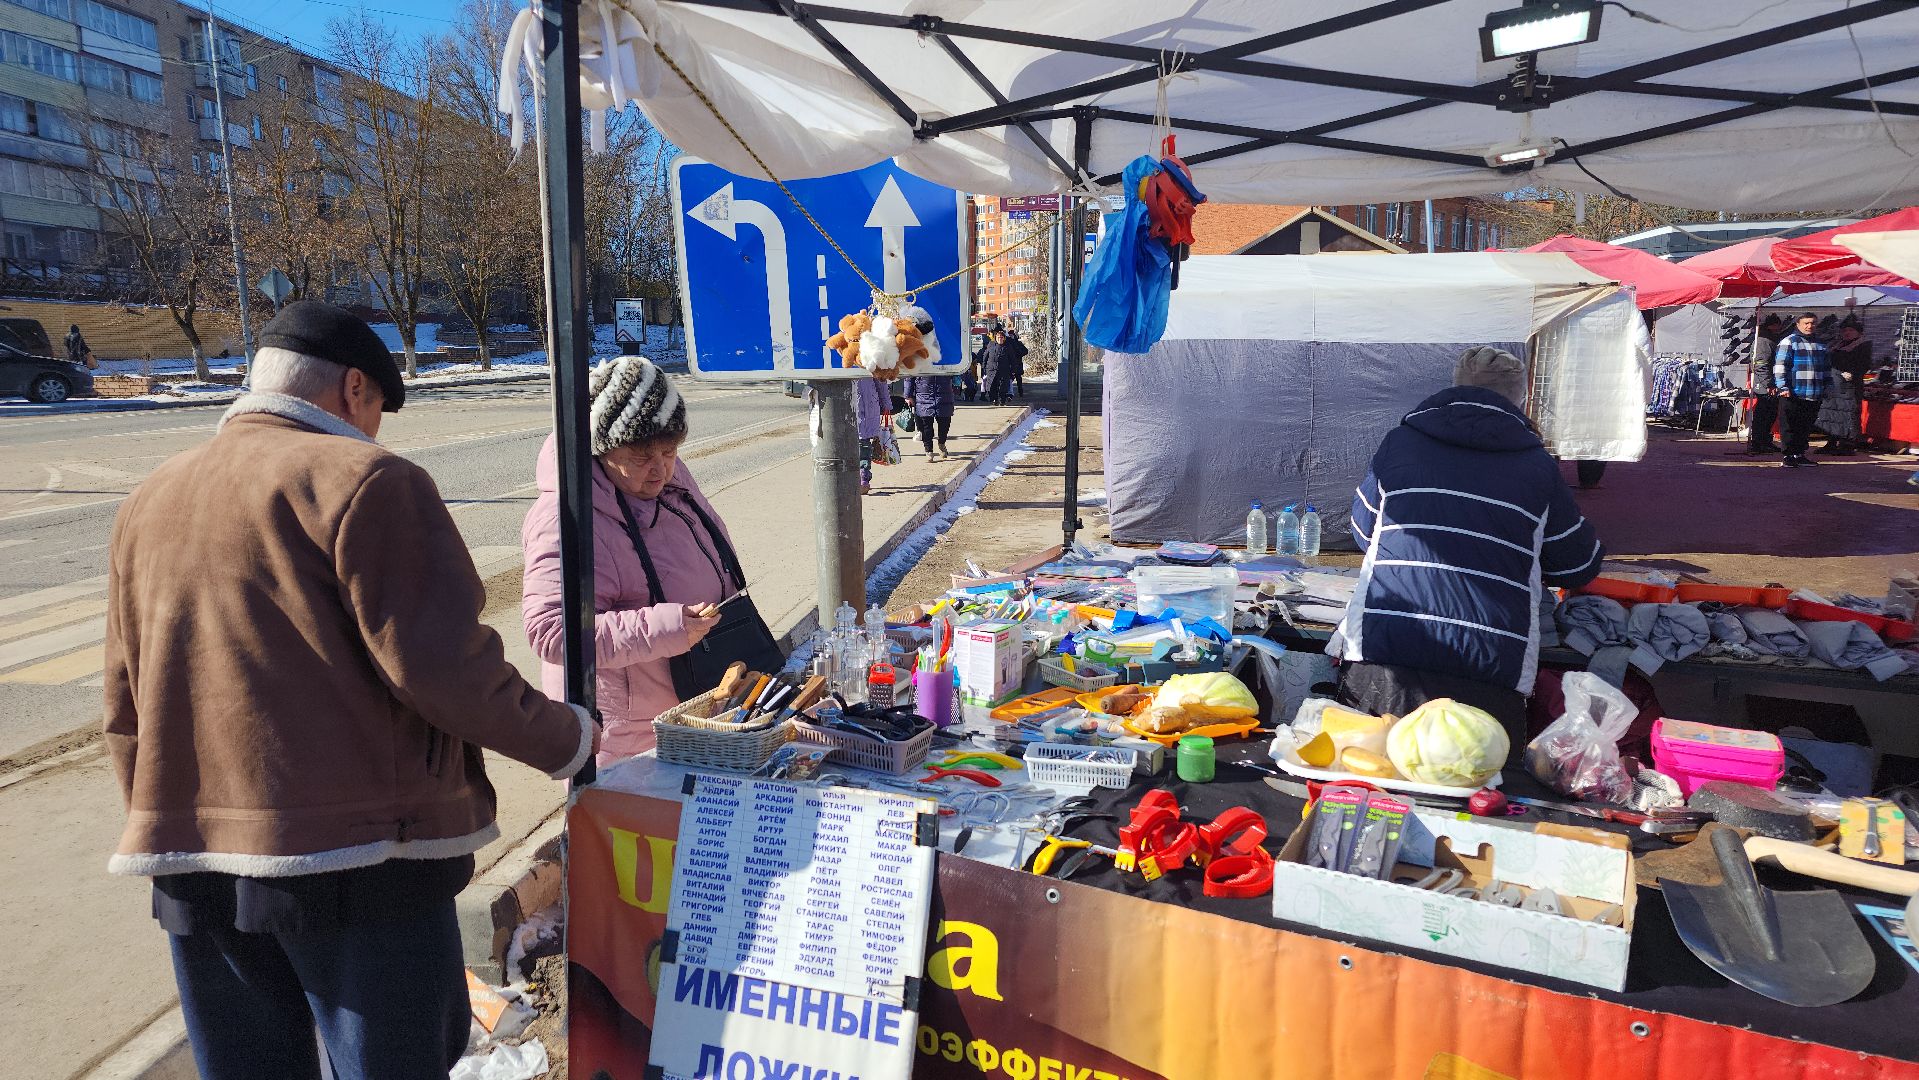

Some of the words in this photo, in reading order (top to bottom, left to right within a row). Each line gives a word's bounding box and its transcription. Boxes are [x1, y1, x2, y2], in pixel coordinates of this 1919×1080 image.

[697, 775, 742, 787] АЛЕКСАНДР
[703, 786, 734, 796] АНДРЕЙ
[754, 783, 797, 793] АНАТОЛИЙ
[756, 793, 793, 804] АРКАДИЙ
[823, 792, 845, 800] ИЛЬЯ
[695, 796, 739, 807] АФАНАСИЙ
[806, 800, 863, 812] КОНСТАНТИН
[879, 798, 914, 808] КИРИЛЛ
[698, 807, 734, 817] АЛЕКСЕЙ
[754, 804, 793, 814] АРСЕНИЙ
[888, 810, 904, 818] ЛЕВ
[696, 817, 732, 827] АЛЬБЕРТ
[816, 812, 851, 822] ЛЕОНИД
[699, 828, 726, 837] АНТОН
[758, 826, 783, 834] АРТУР
[821, 823, 843, 832] МАРК
[813, 833, 848, 843] МИХАИЛ
[875, 830, 912, 841] МАКСИМ
[698, 839, 724, 847] БОРИС
[754, 836, 786, 846] БОГДАН
[754, 847, 782, 856] ВАДИМ
[813, 844, 846, 854] НИКИТА
[878, 842, 907, 851] МАКАР
[690, 849, 729, 860] ВАСИЛИЙ
[814, 855, 841, 864] НАЗАР
[871, 852, 912, 863] НИКОЛАЙ
[690, 859, 727, 870] ВАЛЕРИЙ
[746, 857, 789, 869] ВАЛЕНТИН
[744, 867, 789, 879] ВЛАДИМИР
[879, 864, 900, 873] ОЛЕГ
[683, 869, 731, 881] ВЛАДИСЛАВ
[687, 880, 724, 891] ВИТАЛИЙ
[748, 878, 780, 888] ВИКТОР
[811, 877, 840, 886] РОМАН
[874, 876, 903, 885] ПАВЕЛ
[682, 890, 726, 902] ГЕННАДИЙ
[742, 888, 784, 901] ВЯЧЕСЛАВ
[808, 888, 841, 898] РУСЛАН
[861, 884, 913, 898] РОСТИСЛАВ
[682, 901, 724, 913] ГРИГОРИЙ
[744, 900, 780, 911] ГЕОРГИЙ
[807, 899, 839, 909] СЕРГЕЙ
[691, 913, 711, 921] ГЛЕБ
[745, 911, 776, 921] ГЕРМАН
[797, 908, 848, 921] СТАНИСЛАВ
[865, 908, 904, 920] САВЕЛИЙ
[684, 923, 717, 934] ДАНИИЛ
[745, 922, 773, 932] ДЕНИС
[807, 921, 834, 931] ТАРАС
[866, 919, 901, 930] СТЕПАН
[685, 933, 712, 946] ДАВИД
[738, 932, 778, 944] ДМИТРИЙ
[805, 932, 833, 941] ТИМУР
[861, 930, 904, 943] ТИМОФЕЙ
[687, 945, 706, 954] ЕГОР
[738, 943, 775, 954] ЕВГЕНИЙ
[799, 943, 836, 955] ФИЛИПП
[685, 956, 706, 965] ИВАН
[736, 954, 773, 966] ЕВГЕНИЙ
[799, 954, 833, 966] ЭДУАРД
[863, 953, 898, 965] ФЕЛИКС
[739, 965, 765, 976] ИГОРЬ
[794, 965, 835, 977] ЯРОСЛАВ
[866, 965, 892, 975] ЮРИЙ
[674, 964, 903, 1046] ИМЕННЫЕ
[693, 1044, 859, 1080] ЛОЖ
